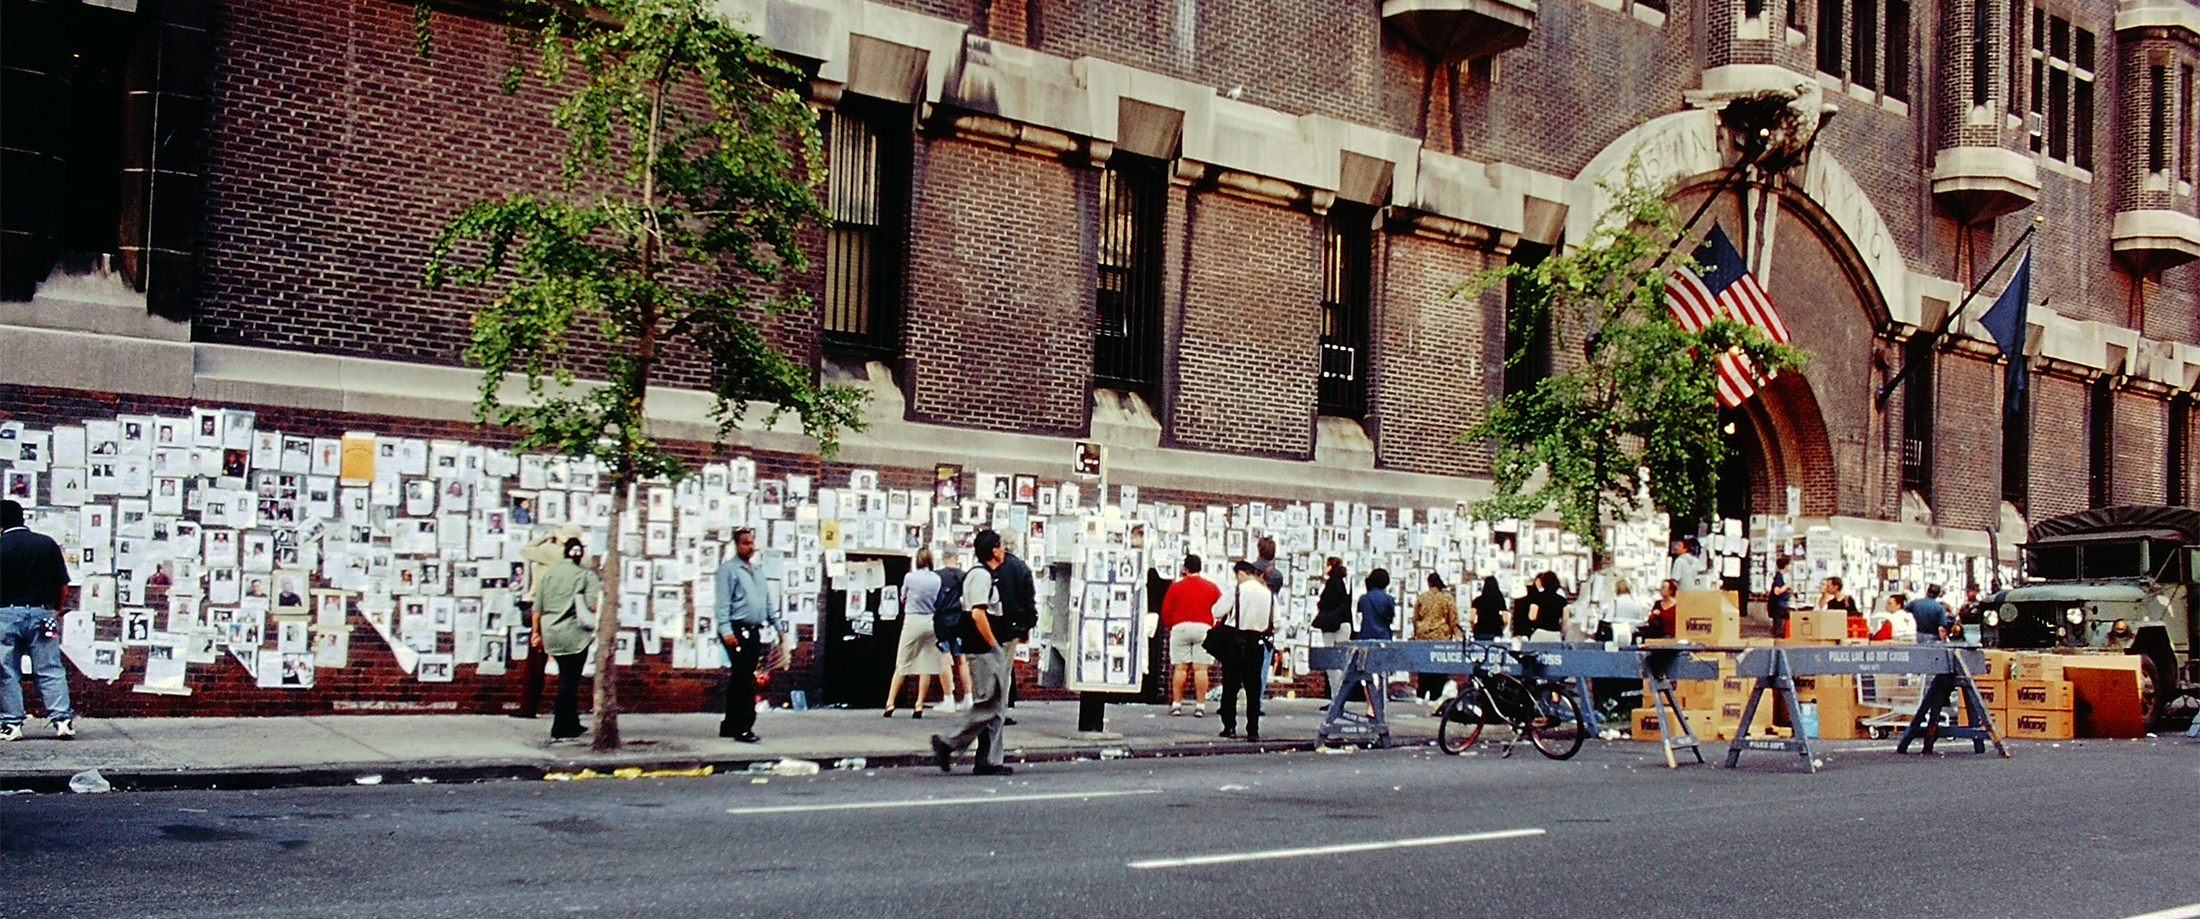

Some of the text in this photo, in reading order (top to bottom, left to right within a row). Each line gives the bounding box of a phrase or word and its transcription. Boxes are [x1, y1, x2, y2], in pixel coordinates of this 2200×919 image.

[1685, 617, 1713, 634] Viking
[1430, 651, 1462, 663] POLICE
[1829, 651, 1850, 662] POLICE
[1851, 651, 1865, 662] LINE
[1876, 651, 1888, 662] NOT
[1889, 652, 1910, 662] CROSS
[2017, 687, 2046, 703] Viking
[2017, 716, 2047, 732] Viking
